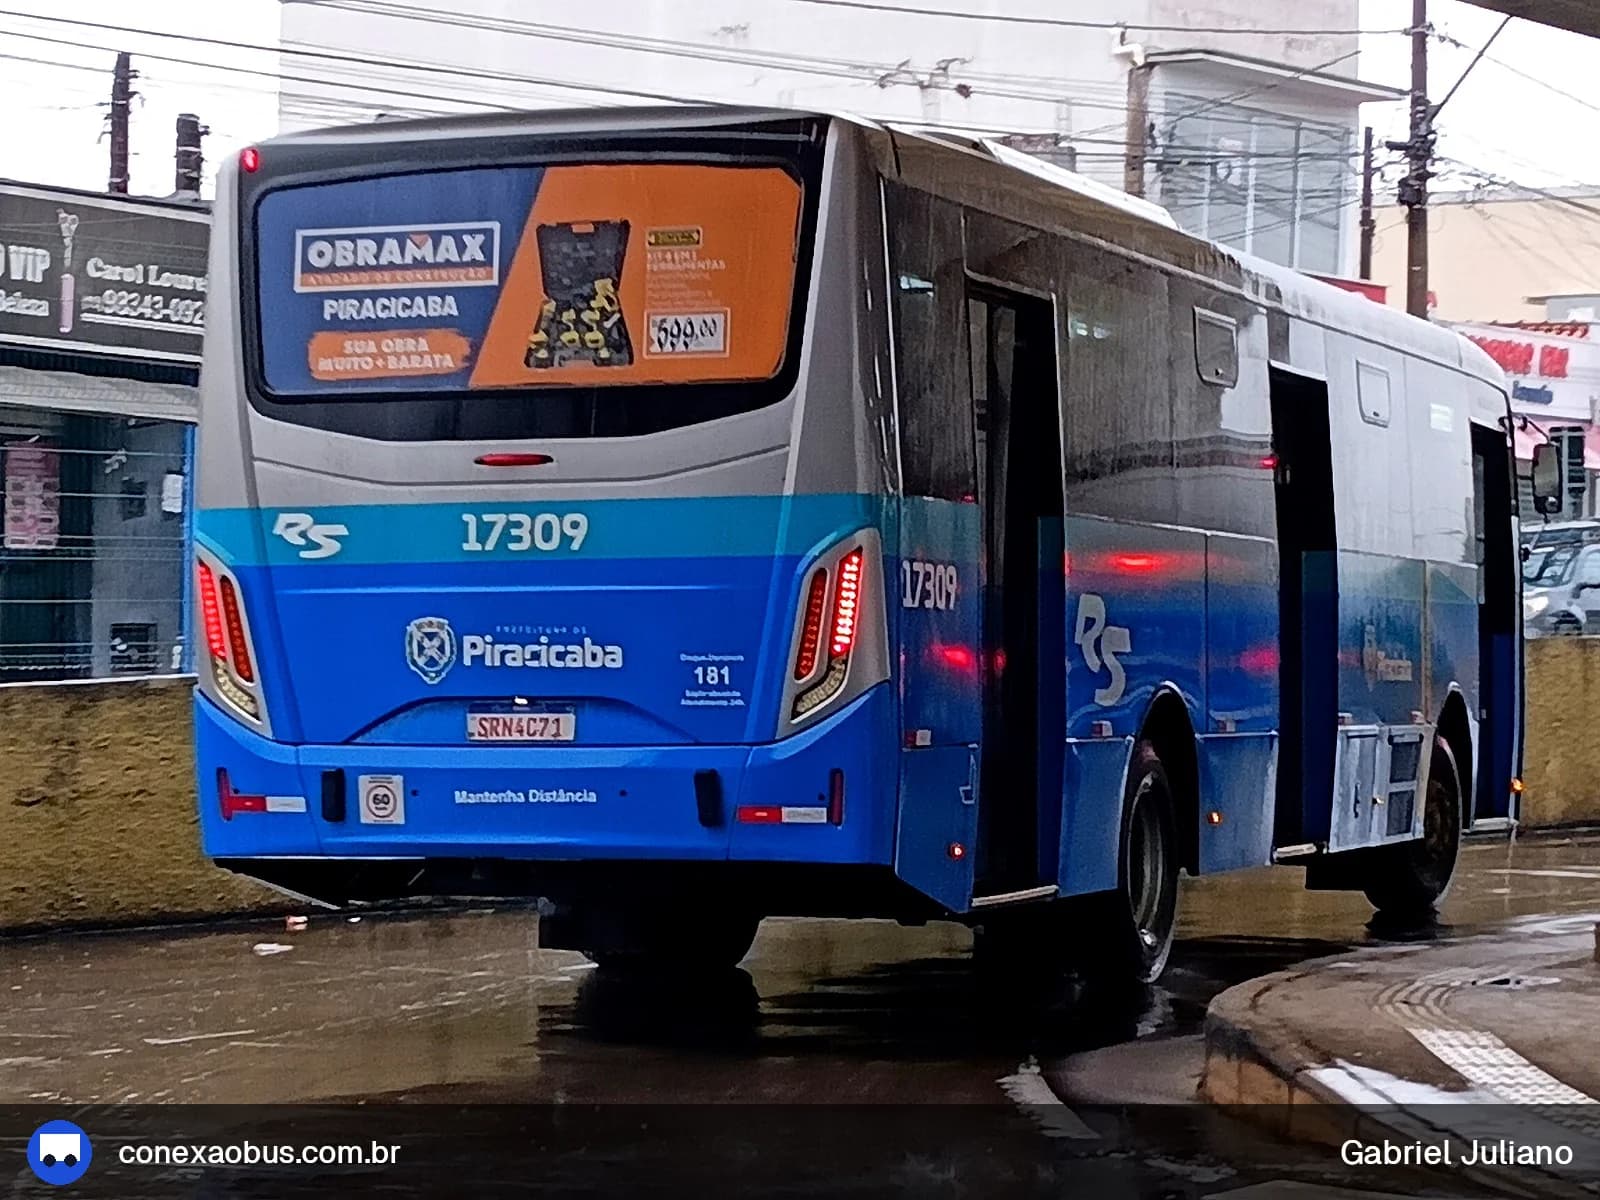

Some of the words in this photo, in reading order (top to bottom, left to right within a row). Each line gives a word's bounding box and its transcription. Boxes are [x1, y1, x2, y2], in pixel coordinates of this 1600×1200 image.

[8, 244, 50, 283] VIP
[307, 233, 485, 268] OBRAMAX
[86, 257, 144, 284] Carol
[323, 295, 459, 321] PIRACICABA
[343, 338, 378, 354] SUA
[381, 336, 430, 353] OBRA
[318, 356, 374, 371] MUITO
[387, 353, 456, 370] BARATA
[462, 513, 589, 551] 17309
[902, 560, 958, 610] 17309
[463, 634, 623, 668] Piracicaba
[694, 665, 729, 685] 181
[477, 716, 562, 738] SRN4C71
[372, 793, 390, 805] 60
[454, 790, 526, 804] Mantenha
[528, 789, 598, 803] Distância
